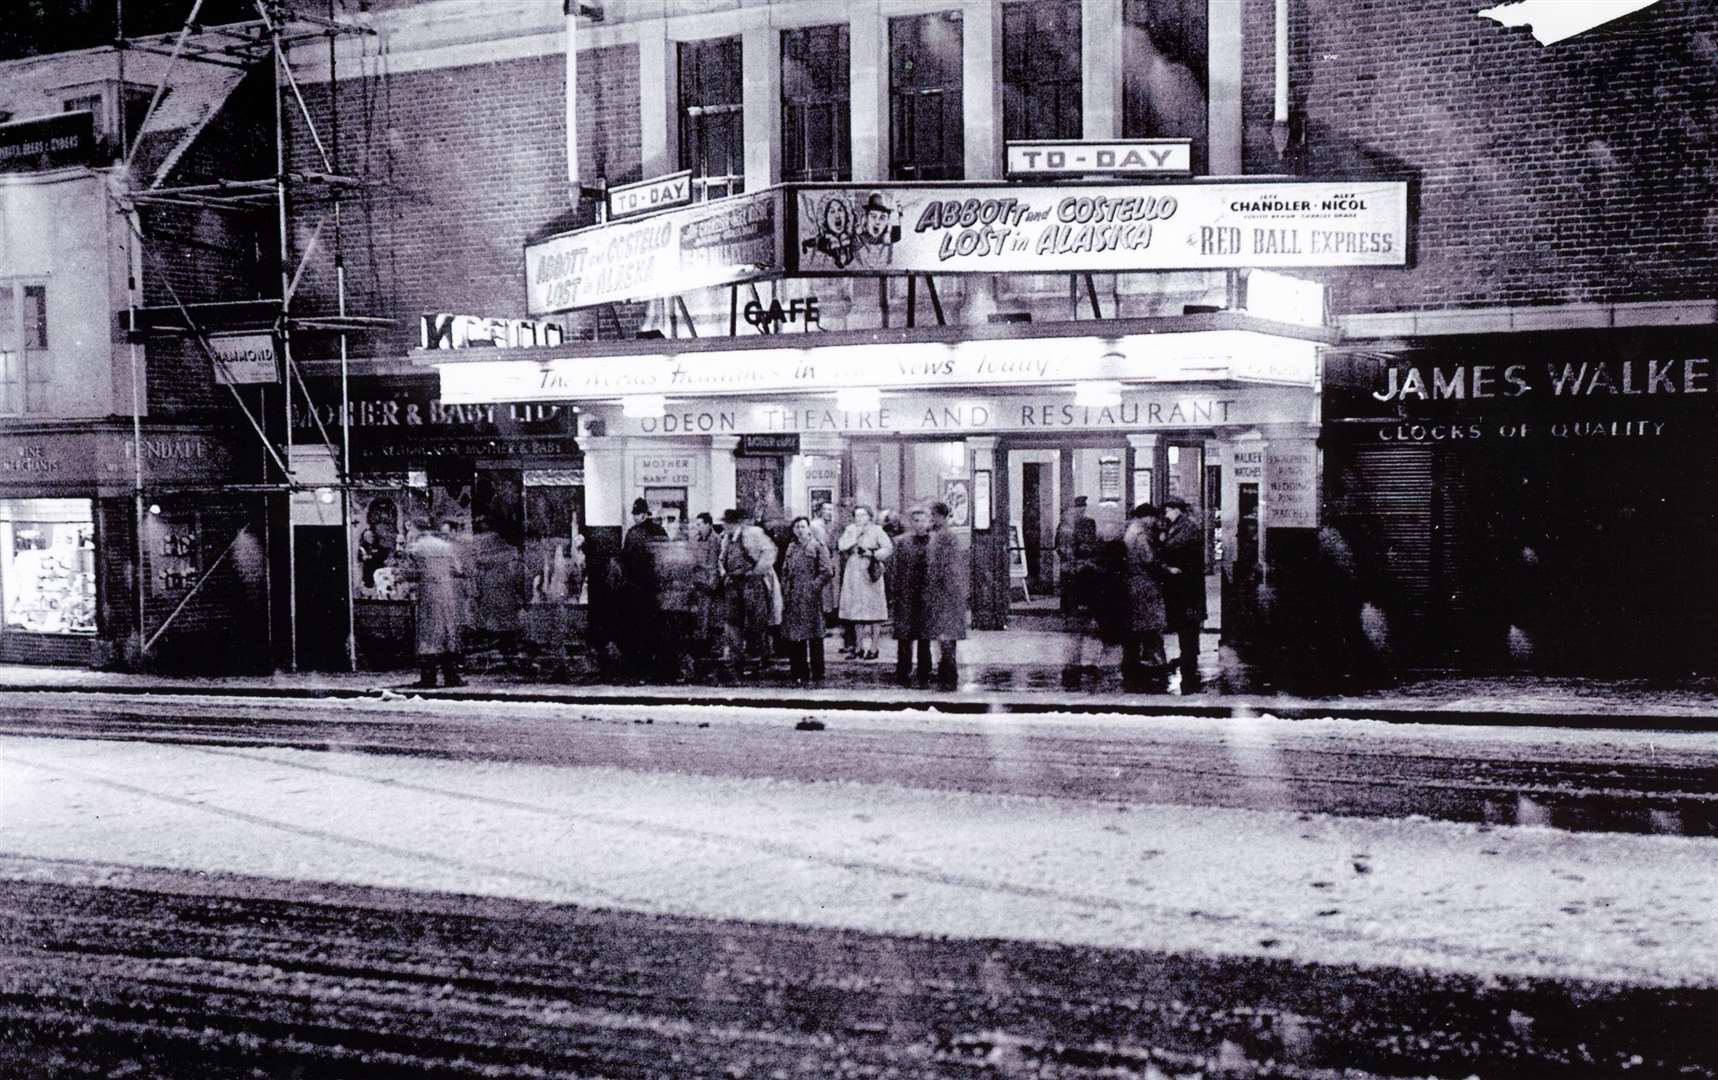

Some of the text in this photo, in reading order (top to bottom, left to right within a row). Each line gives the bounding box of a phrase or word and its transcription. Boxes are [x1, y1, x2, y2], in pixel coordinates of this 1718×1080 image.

[1022, 149, 1173, 168] TO-DAY
[618, 183, 685, 211] TO-DAY
[1230, 199, 1368, 212] CHANDLER NICOL
[914, 195, 1178, 233] ABBOTT and COSTELLO
[938, 221, 1154, 261] LOST in ALASKA
[1200, 225, 1242, 256] RED
[1252, 227, 1302, 254] BALL
[1310, 230, 1393, 254] EXPRESS
[744, 296, 819, 326] CAFE
[794, 358, 816, 380] in
[1372, 358, 1718, 402] JAMES WALKE
[406, 404, 423, 427] &
[430, 400, 496, 426] BABY
[641, 400, 1236, 434] ODEON THEATRE AND RESTAURANT
[1378, 419, 1666, 442] CLOCKS OF QUALITY
[642, 460, 689, 468] MOTHER
[1234, 466, 1262, 477] WATCHES
[642, 475, 689, 483] BABY LTD
